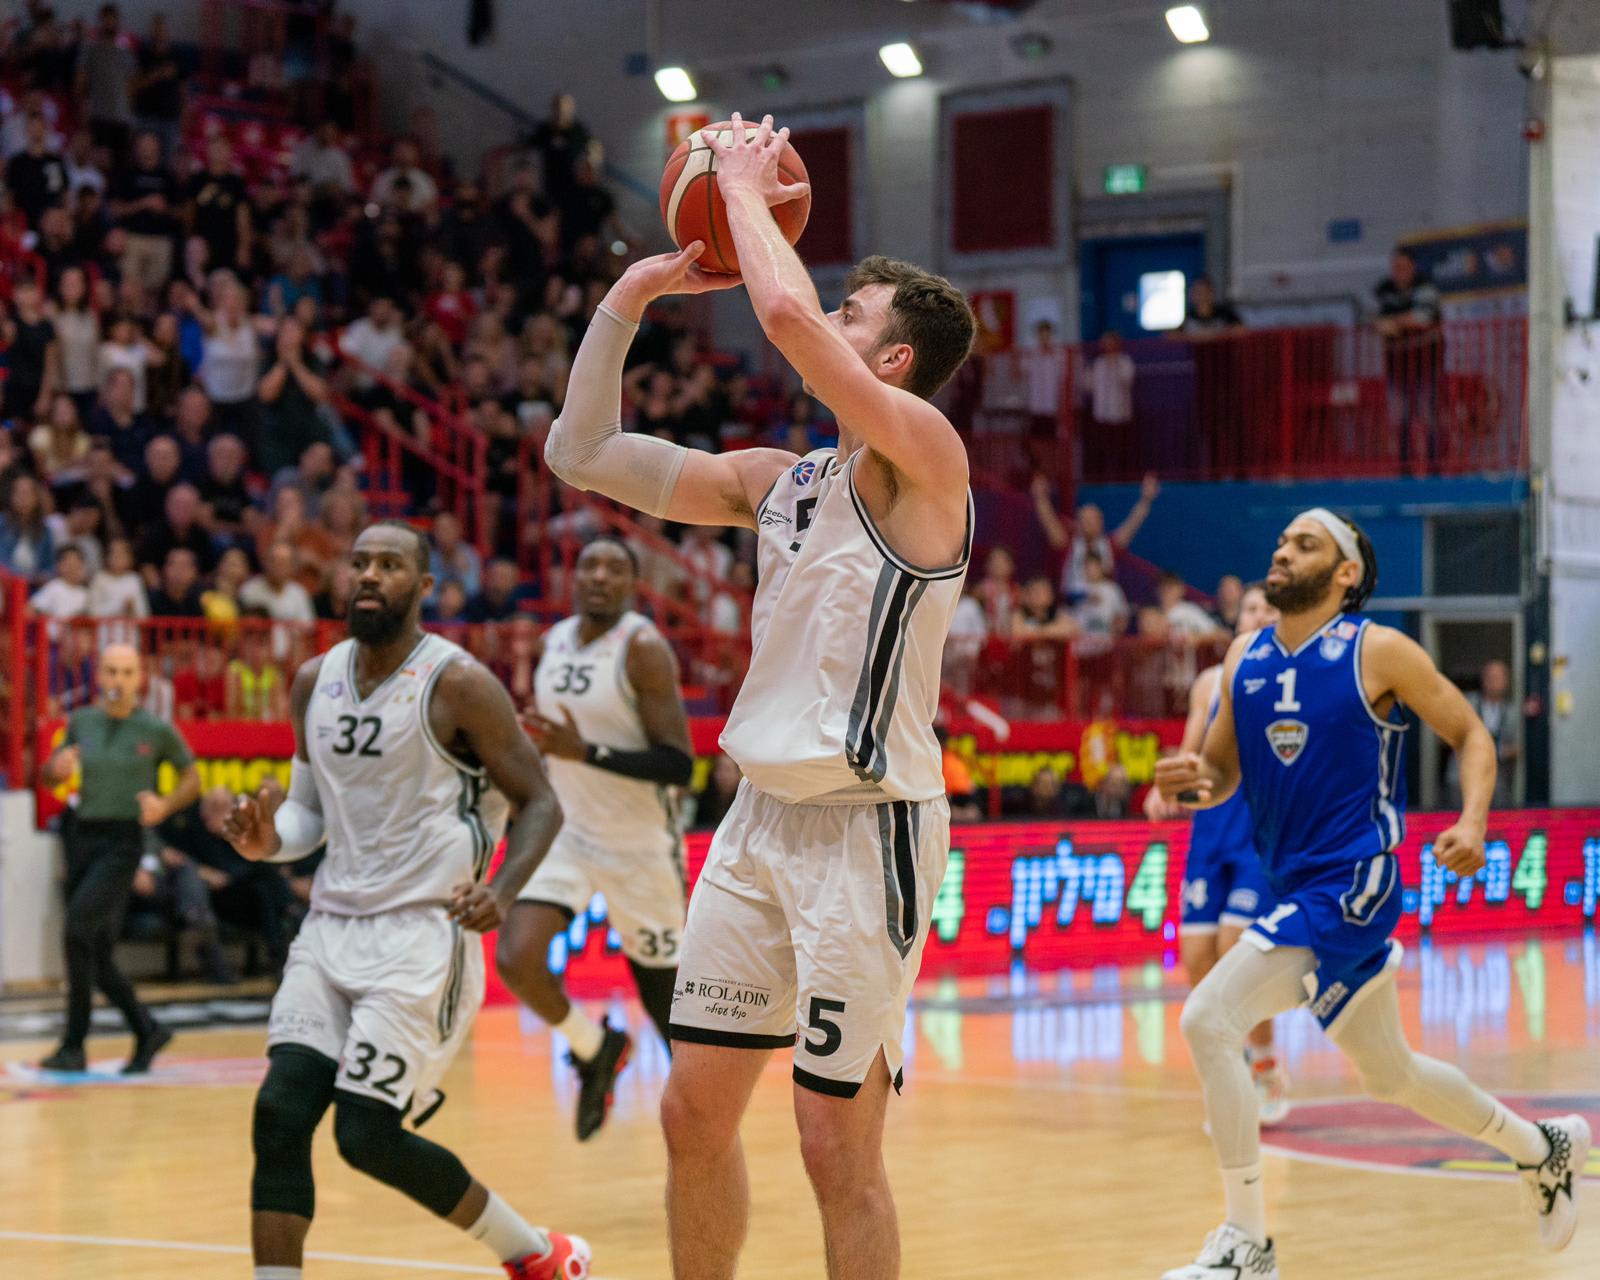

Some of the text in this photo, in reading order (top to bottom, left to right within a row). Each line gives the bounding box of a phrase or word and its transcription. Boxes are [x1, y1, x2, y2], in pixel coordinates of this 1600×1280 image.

[553, 664, 594, 696] 35
[1274, 667, 1301, 712] 1
[332, 714, 383, 757] 32
[1126, 843, 1167, 929] 4
[1512, 835, 1548, 909] 4
[1257, 903, 1299, 934] 1
[638, 928, 677, 957] 35
[698, 983, 770, 1007] ROLADIN
[805, 996, 846, 1056] 5
[346, 1042, 407, 1098] 32
